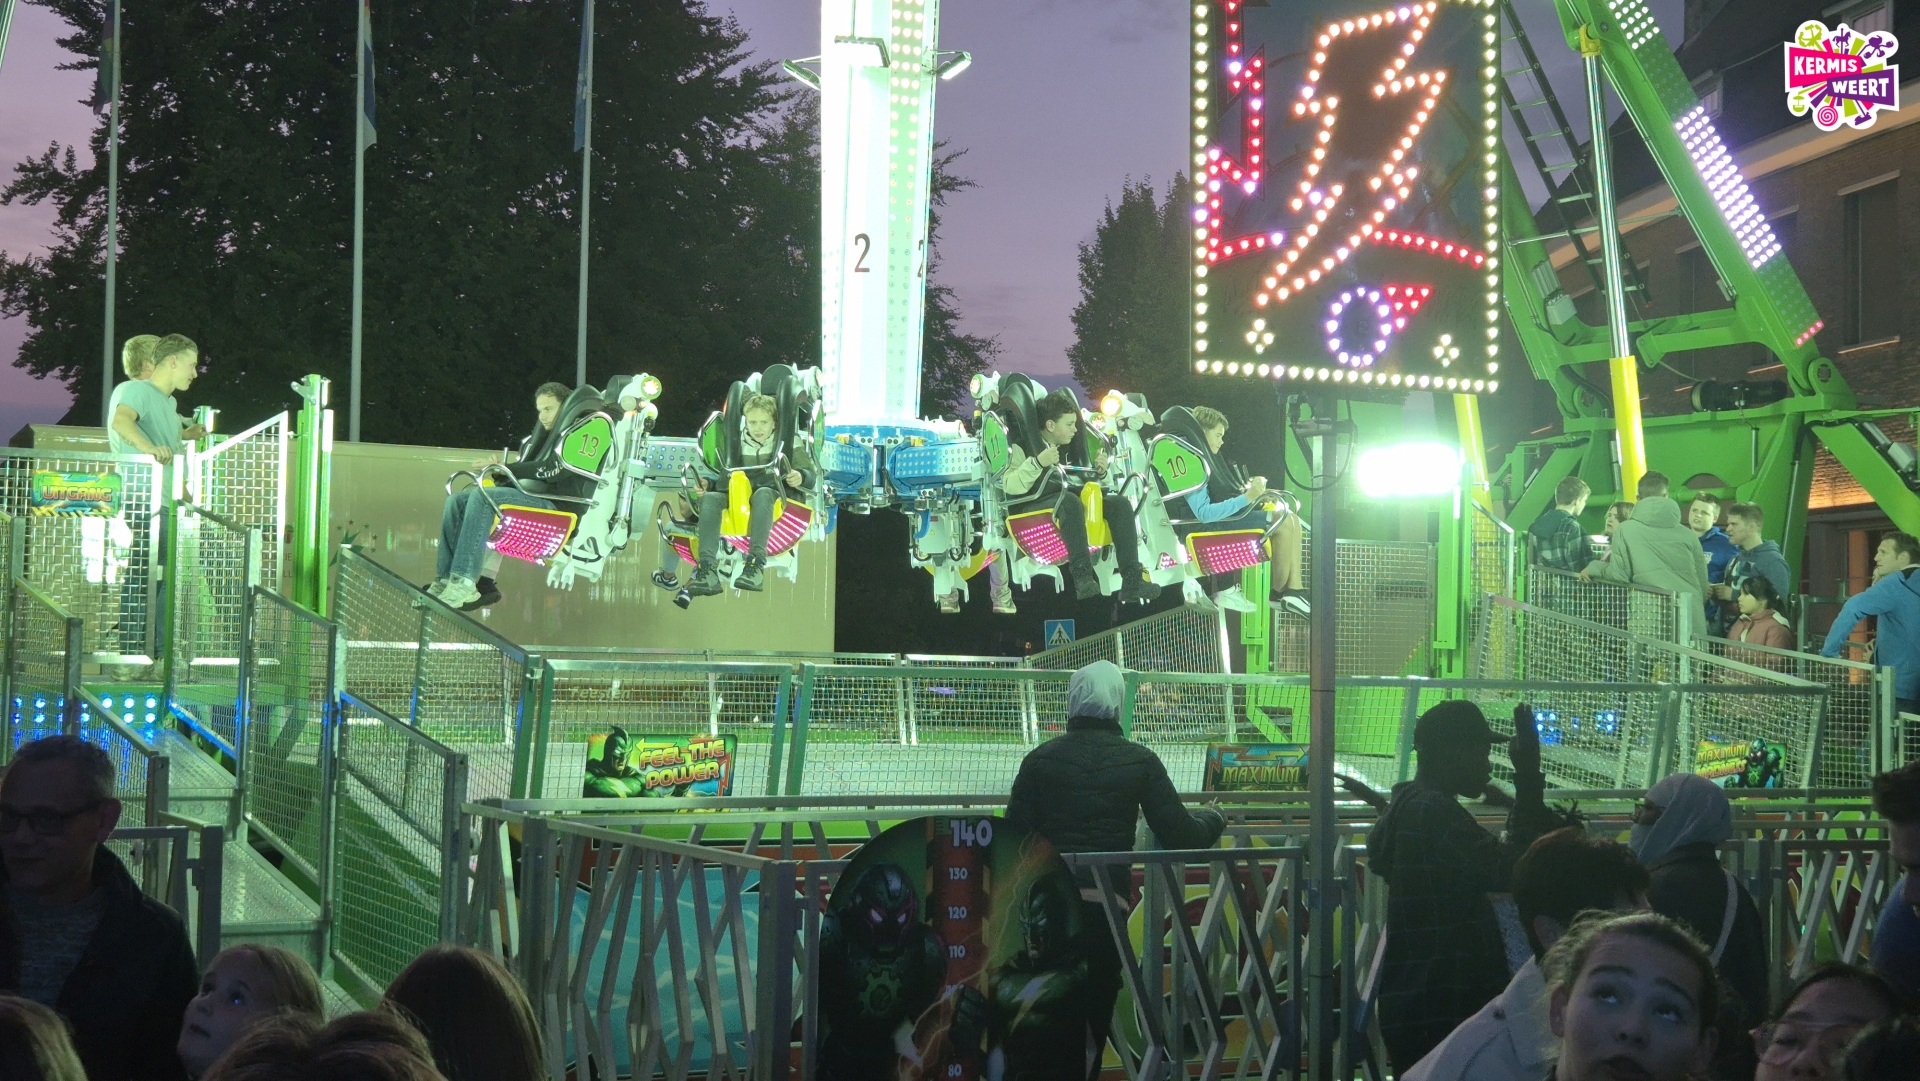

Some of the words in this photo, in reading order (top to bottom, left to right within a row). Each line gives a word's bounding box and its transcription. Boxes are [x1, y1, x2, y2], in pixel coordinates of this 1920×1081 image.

[854, 233, 871, 273] 2
[579, 433, 599, 458] 13
[990, 434, 1001, 459] 11
[1166, 454, 1187, 480] 10
[42, 485, 113, 502] UITGANG
[638, 747, 684, 770] FEEL
[688, 739, 725, 761] THE
[1697, 744, 1747, 763] MAXIMUM
[645, 761, 720, 790] POWER
[1221, 764, 1301, 789] MAXIMUM
[950, 819, 993, 847] 140
[949, 867, 968, 880] 130
[948, 906, 967, 919] 120
[948, 945, 966, 958] 110
[948, 1064, 962, 1077] 80
